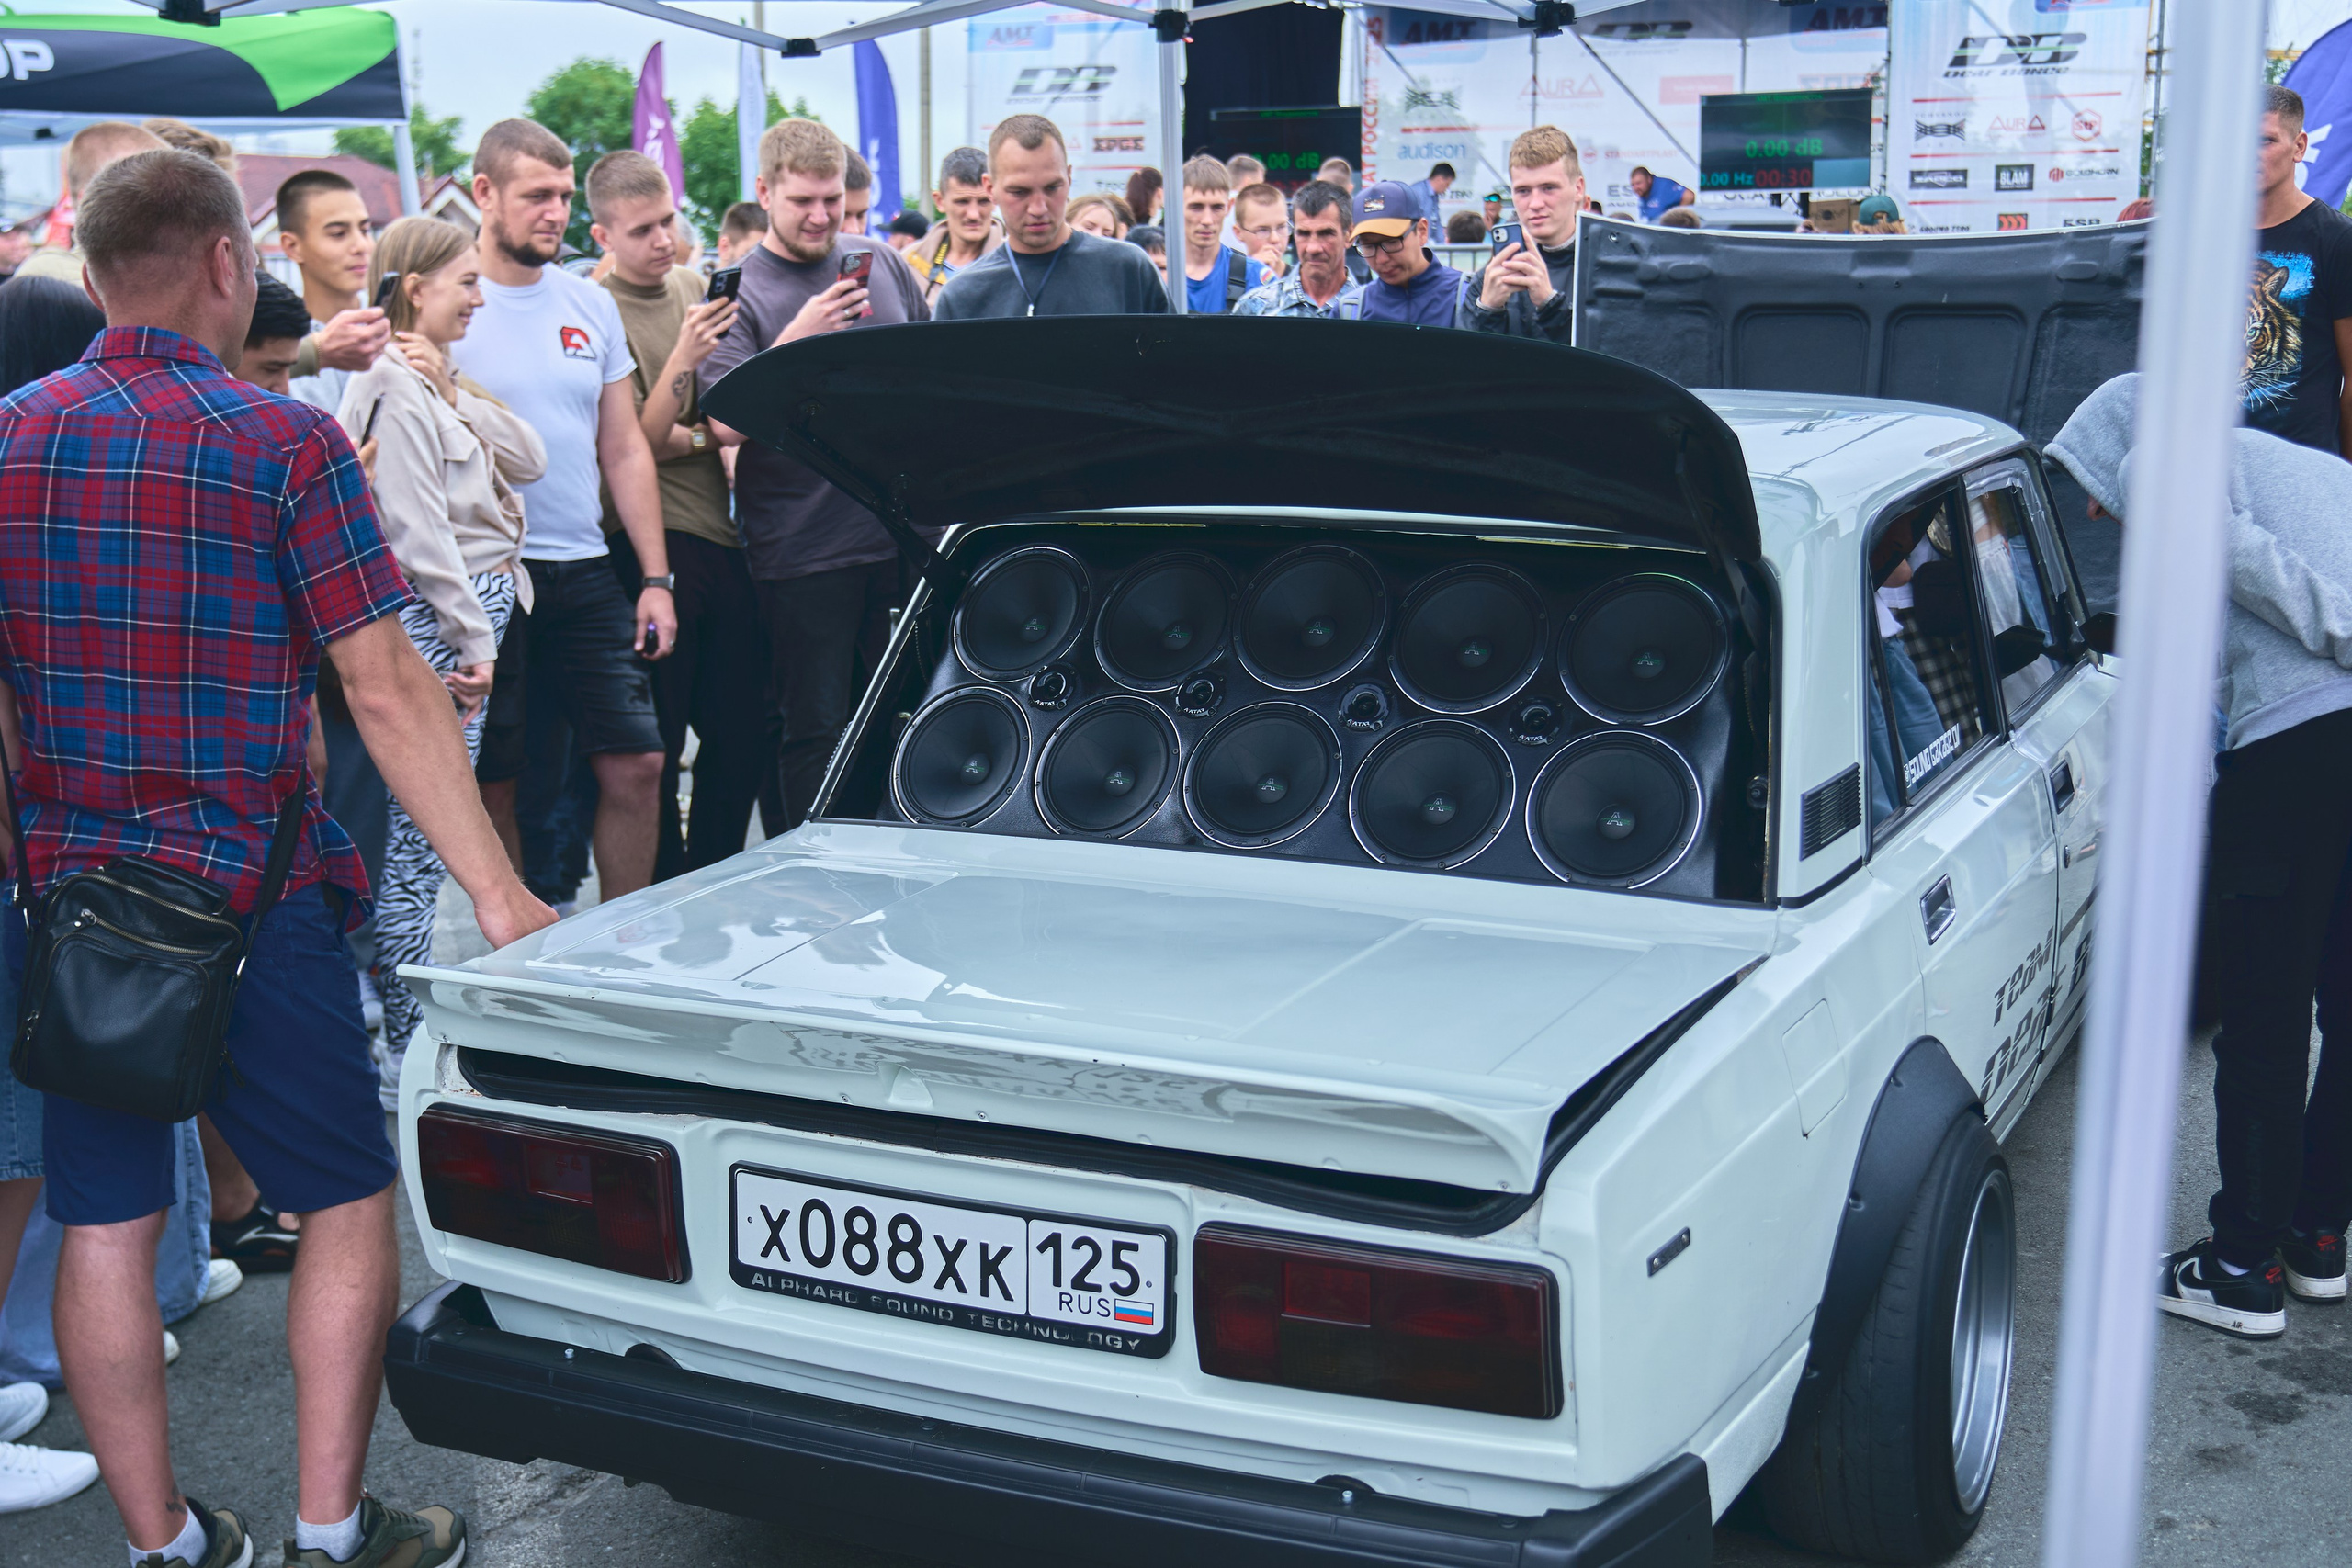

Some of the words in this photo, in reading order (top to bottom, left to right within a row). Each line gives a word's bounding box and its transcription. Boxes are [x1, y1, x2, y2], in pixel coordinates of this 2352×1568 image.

[1398, 141, 1467, 161] audison
[1745, 140, 1790, 158] 0.00
[1794, 138, 1824, 157] dB
[1733, 171, 1754, 186] Hz
[1755, 168, 1813, 188] 00:30
[1999, 170, 2029, 185] BLAM
[1035, 1231, 1143, 1298] 125
[1057, 1292, 1112, 1319] RUS
